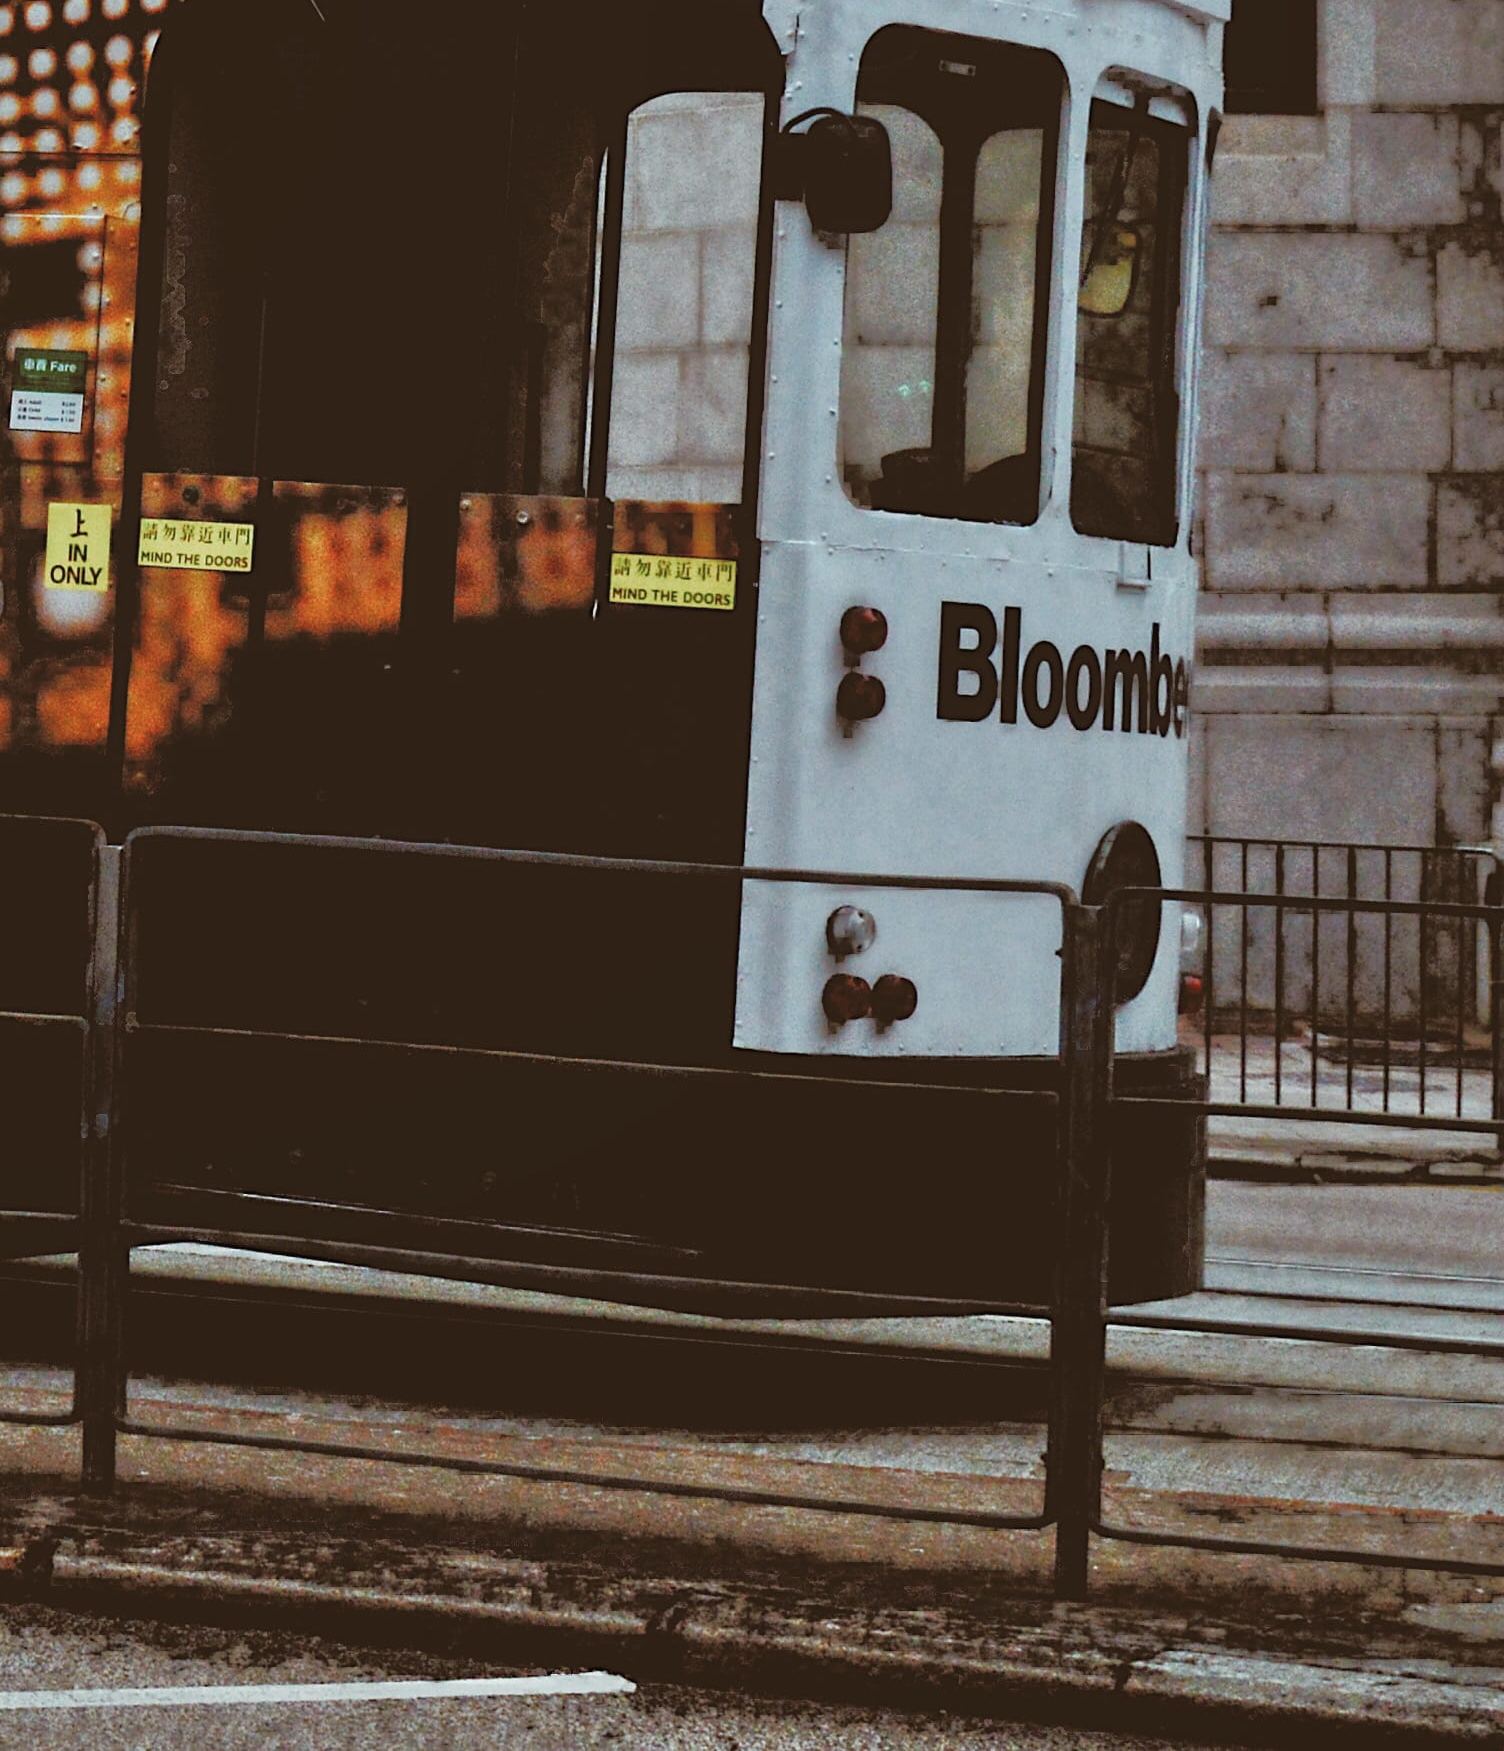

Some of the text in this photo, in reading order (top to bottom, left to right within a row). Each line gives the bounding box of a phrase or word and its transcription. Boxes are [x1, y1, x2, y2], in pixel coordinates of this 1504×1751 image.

[50, 360, 77, 373] Fare
[69, 508, 89, 539] 上
[68, 543, 88, 563] IN
[140, 550, 249, 569] MIND THE DOORS
[49, 565, 102, 588] ONLY
[612, 586, 731, 606] MIND THE DOORS
